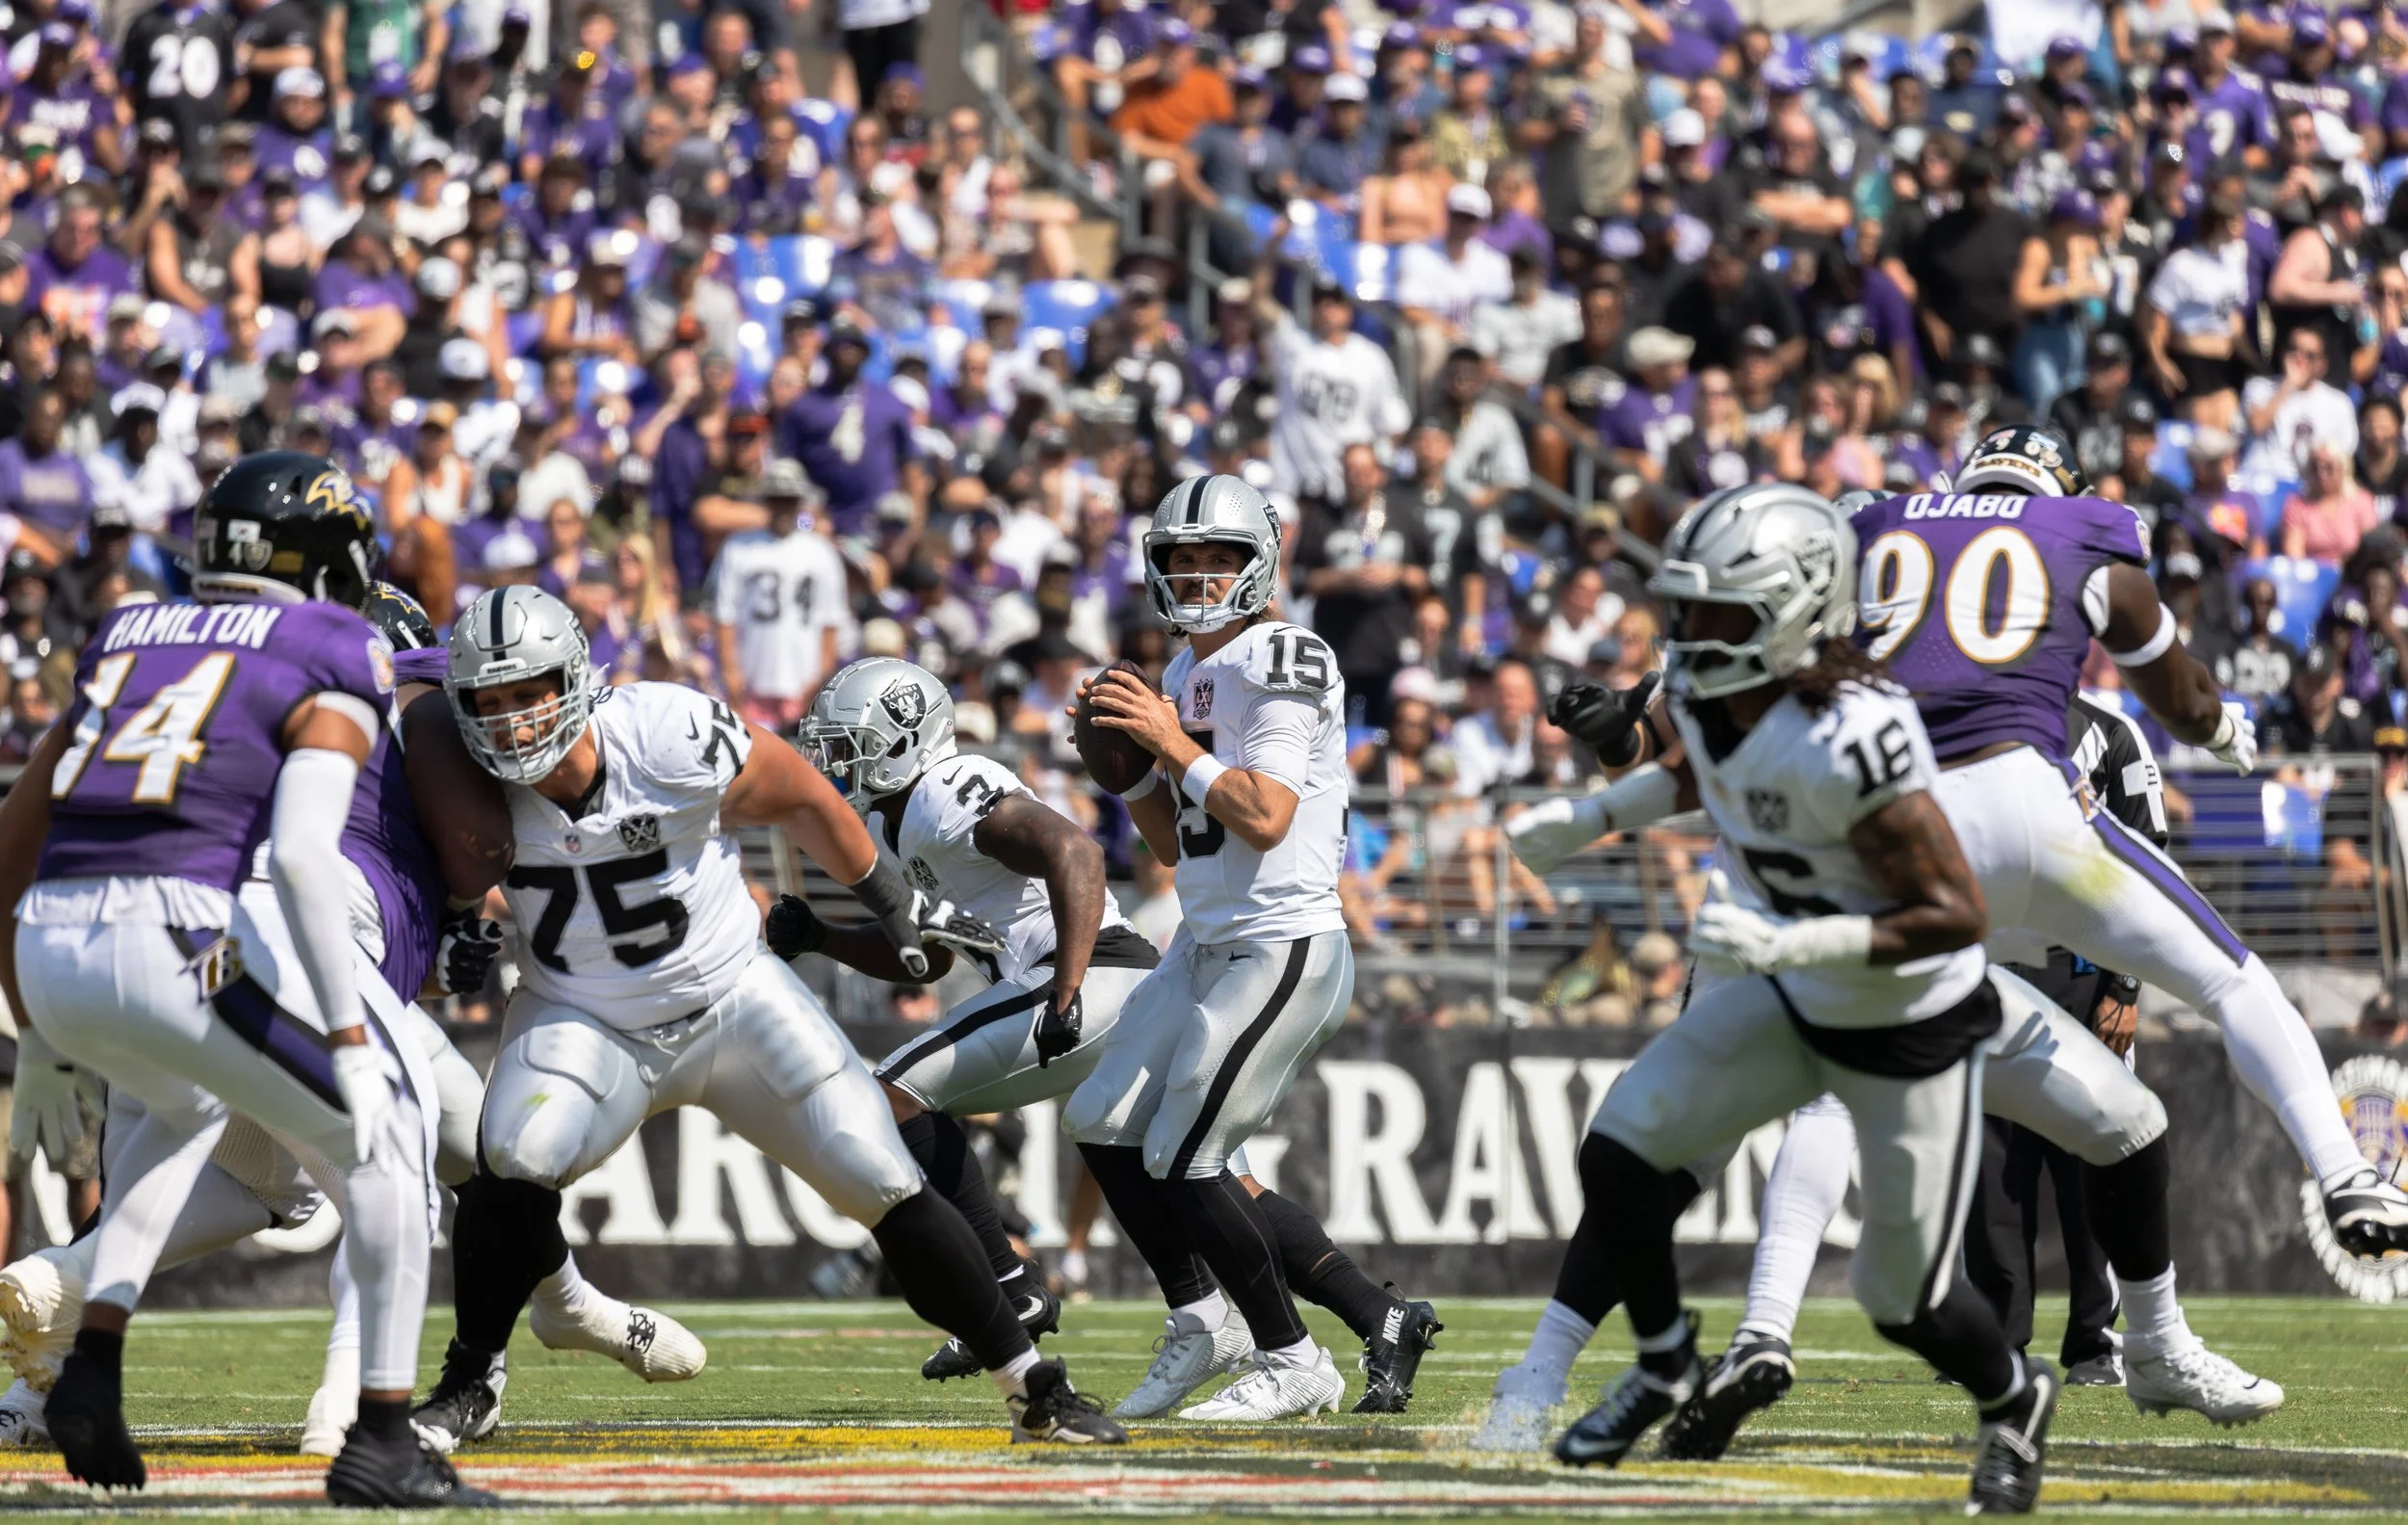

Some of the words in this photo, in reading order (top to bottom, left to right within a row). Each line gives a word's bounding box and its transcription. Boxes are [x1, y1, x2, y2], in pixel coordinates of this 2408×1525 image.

[147, 34, 220, 98] 20
[1903, 493, 2028, 519] OJABO
[749, 569, 813, 627] 34
[1859, 525, 2050, 665] 90
[103, 603, 281, 652] HAMILTON
[1266, 633, 1329, 691] 15
[883, 684, 918, 701] RAIDERS
[1843, 719, 1913, 798] 16
[956, 774, 1004, 818] 3
[507, 848, 690, 976] 75
[1316, 1056, 1864, 1249] RAV
[1382, 1306, 1404, 1345] NIKE
